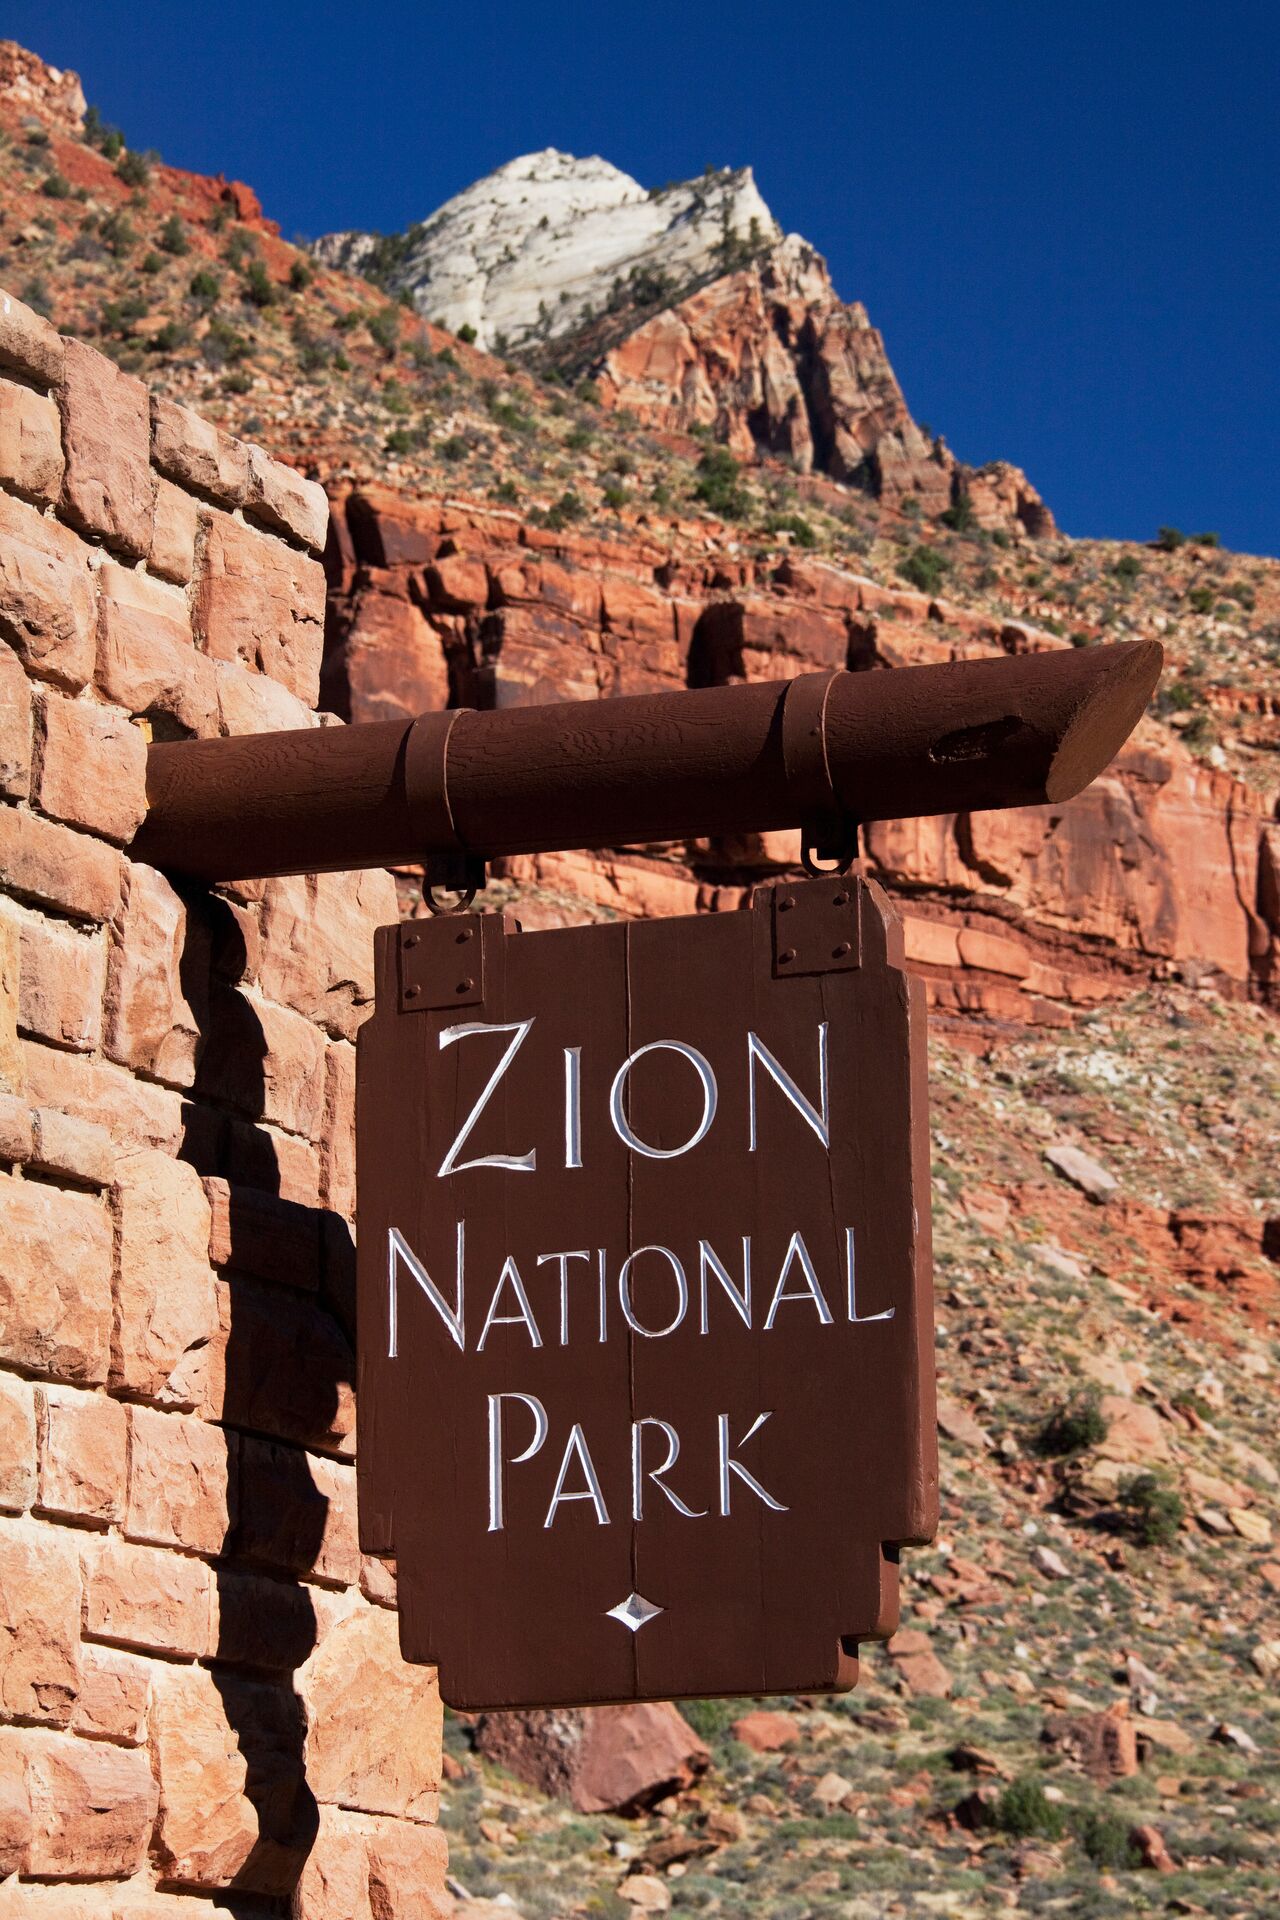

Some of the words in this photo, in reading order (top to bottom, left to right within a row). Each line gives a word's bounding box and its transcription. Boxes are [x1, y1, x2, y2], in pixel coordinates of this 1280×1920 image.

[437, 1017, 831, 1178] ZION
[386, 1218, 896, 1359] NATIONAL
[486, 1391, 790, 1532] PARK
